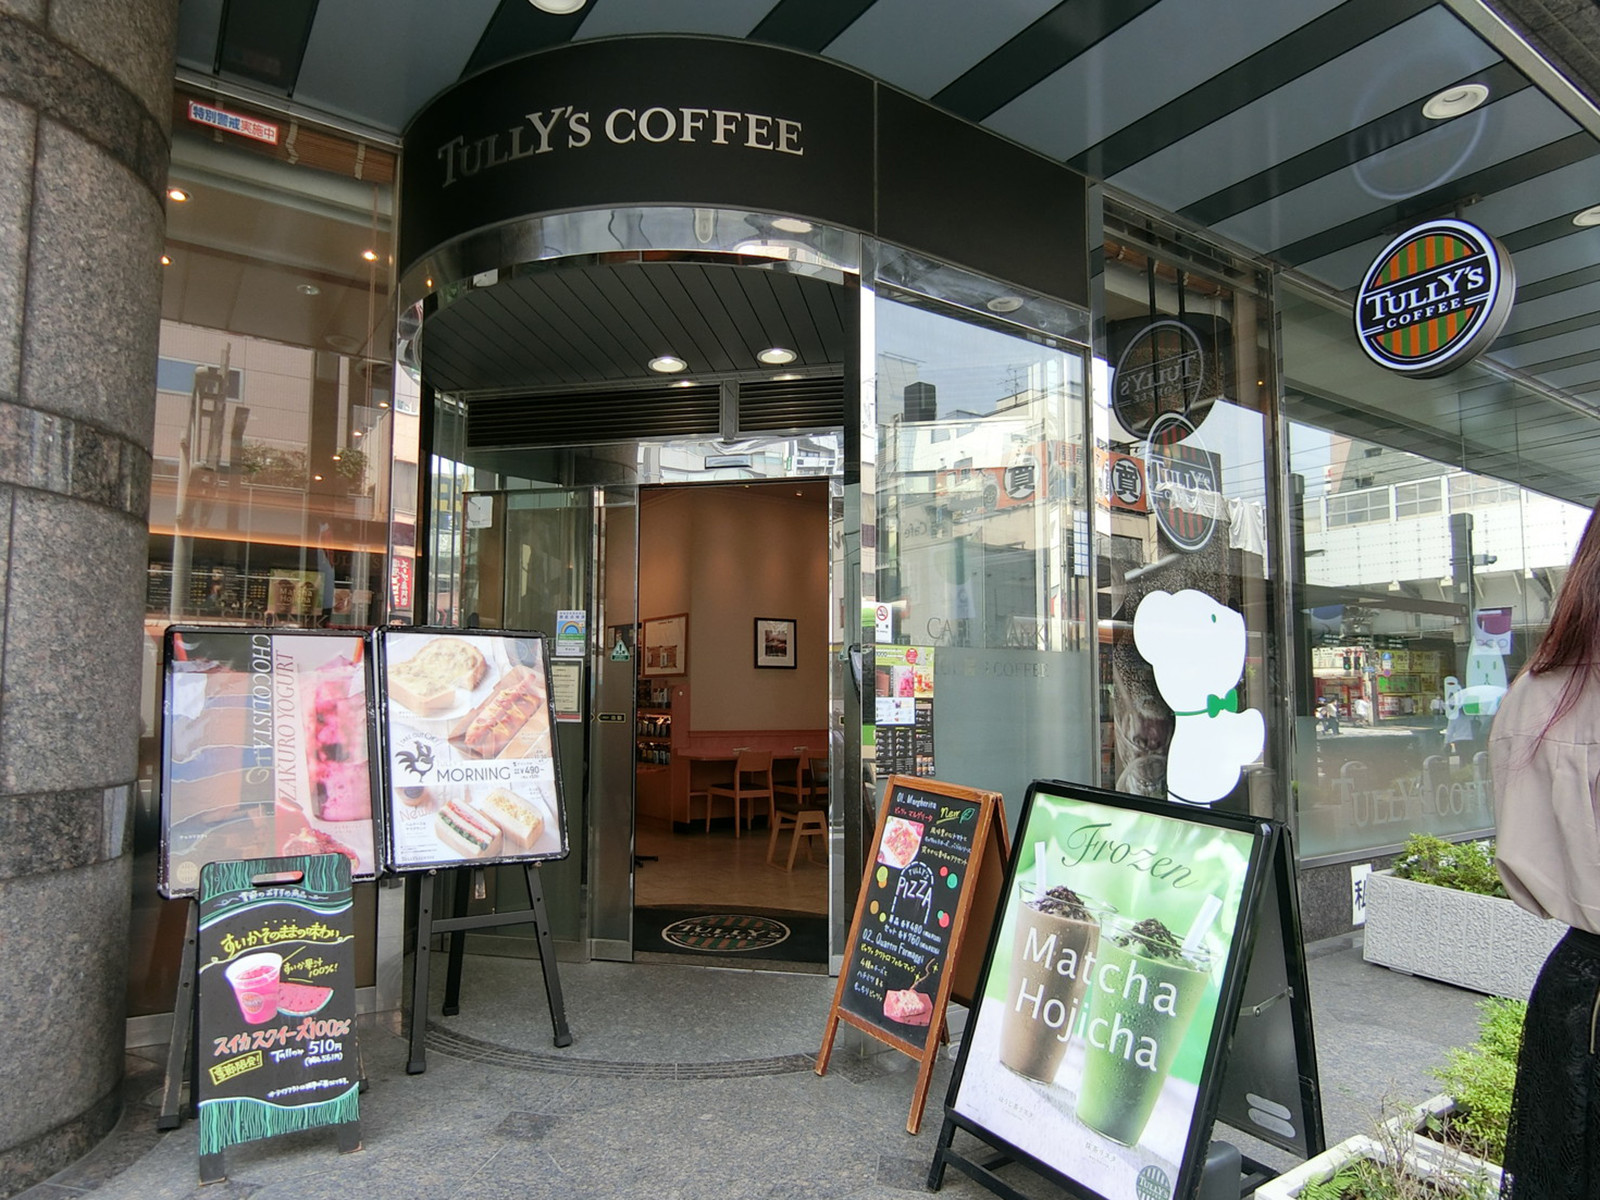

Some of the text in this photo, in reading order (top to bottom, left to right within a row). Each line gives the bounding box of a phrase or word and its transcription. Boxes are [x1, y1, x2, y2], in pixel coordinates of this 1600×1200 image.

[193, 105, 275, 140] 特別警戒実施中
[437, 105, 804, 188] TULLY'S COFFEE
[1366, 266, 1485, 321] TULLY'S
[1386, 298, 1461, 329] COFFEE
[252, 634, 273, 749] CHOCOLISTA
[276, 650, 297, 801] ZAKURO YOGURT
[437, 766, 511, 783] MORNING
[1061, 822, 1200, 890] Frozen
[895, 875, 933, 908] PIZZA
[220, 921, 340, 959] すいかそのままの味わい
[283, 956, 323, 975] すいか果汁
[1022, 926, 1179, 1018] Matcha
[308, 1038, 343, 1055] 510円
[1014, 977, 1160, 1073] Hojicha
